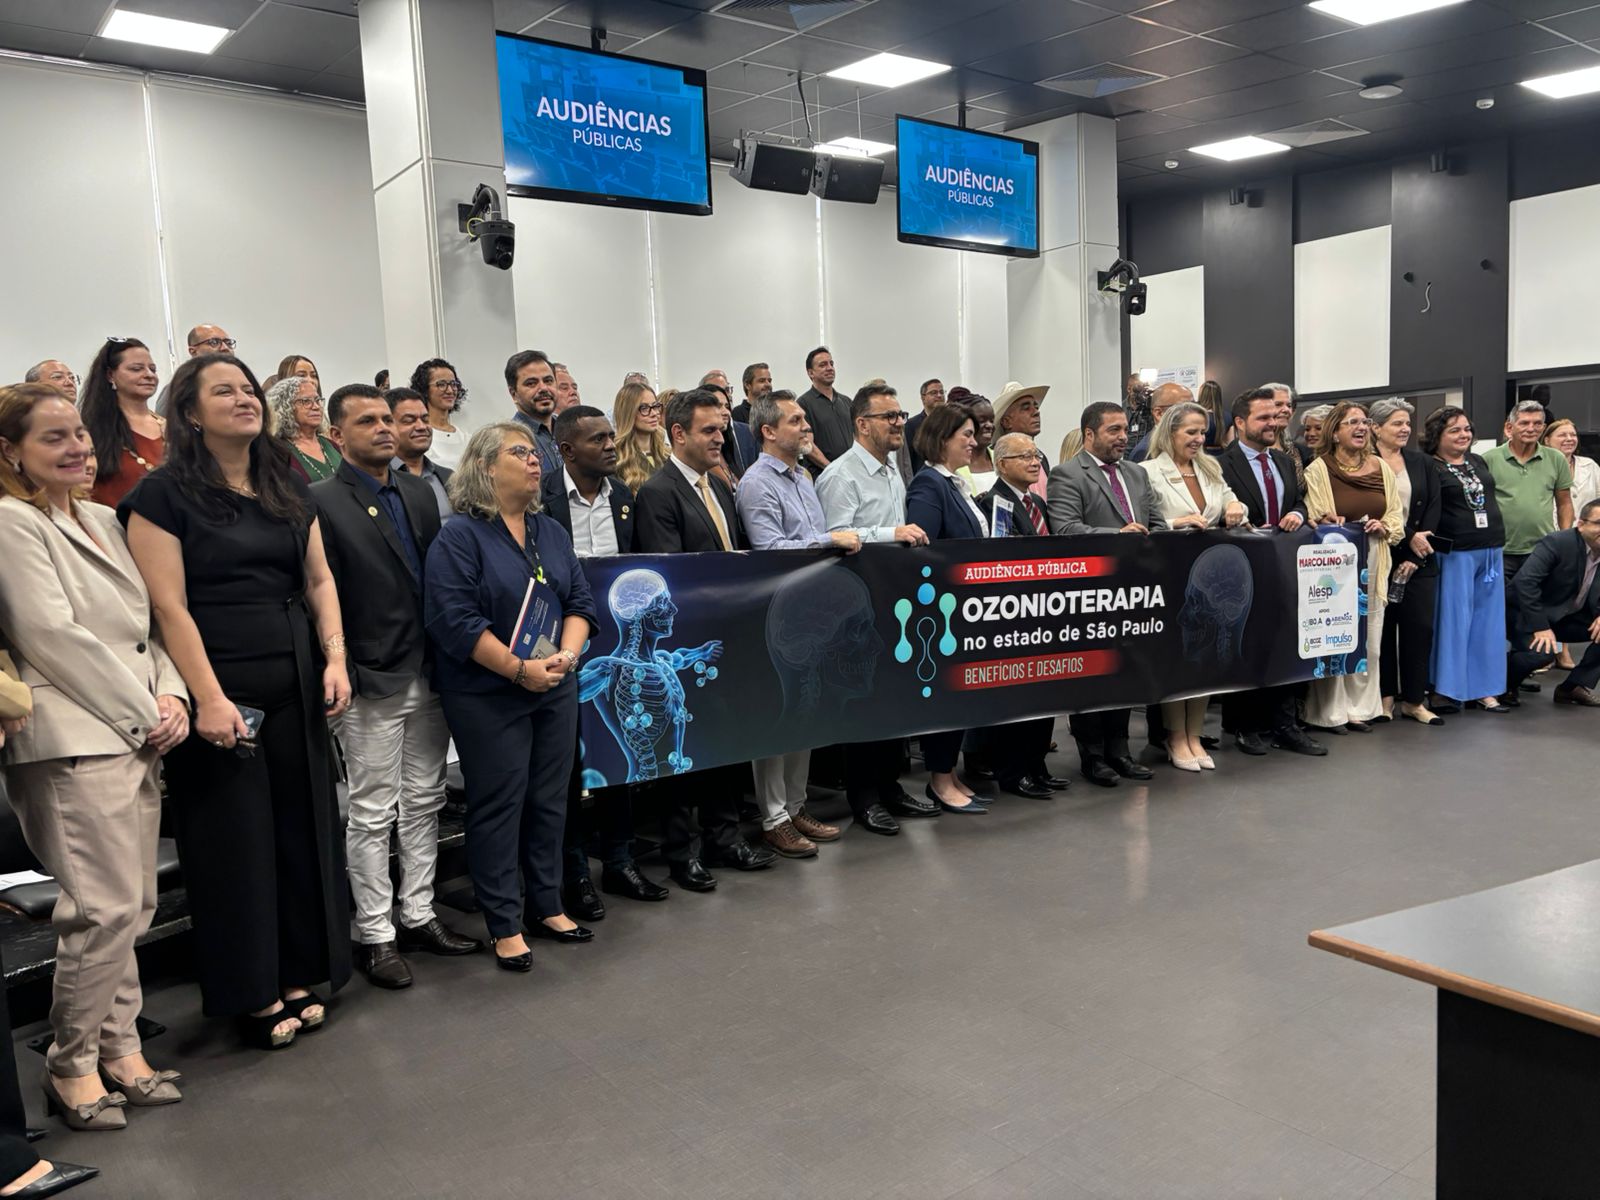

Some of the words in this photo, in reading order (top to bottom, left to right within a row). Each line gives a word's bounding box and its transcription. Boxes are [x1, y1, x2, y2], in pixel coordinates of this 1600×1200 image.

[537, 96, 671, 136] AUDIÊNCIAS
[573, 127, 643, 152] PÚBLICAS
[925, 164, 1014, 195] AUDIÊNCIAS
[948, 188, 994, 208] PÚBLICAS
[964, 564, 1035, 580] AUDIÊNCIA
[1037, 561, 1088, 576] PÚBLICA
[1299, 556, 1342, 568] MARCOLINO
[962, 585, 1165, 623] OZONIOTERAPIA
[1308, 584, 1333, 599] Alesp
[963, 636, 987, 651] no
[993, 627, 1053, 648] estado
[1059, 625, 1081, 642] de
[1086, 622, 1117, 640] São
[1122, 617, 1164, 637] Paulo
[964, 662, 1025, 685] BENEFÍCIOS
[1027, 661, 1035, 678] E
[1037, 657, 1084, 677] DESAFIOS
